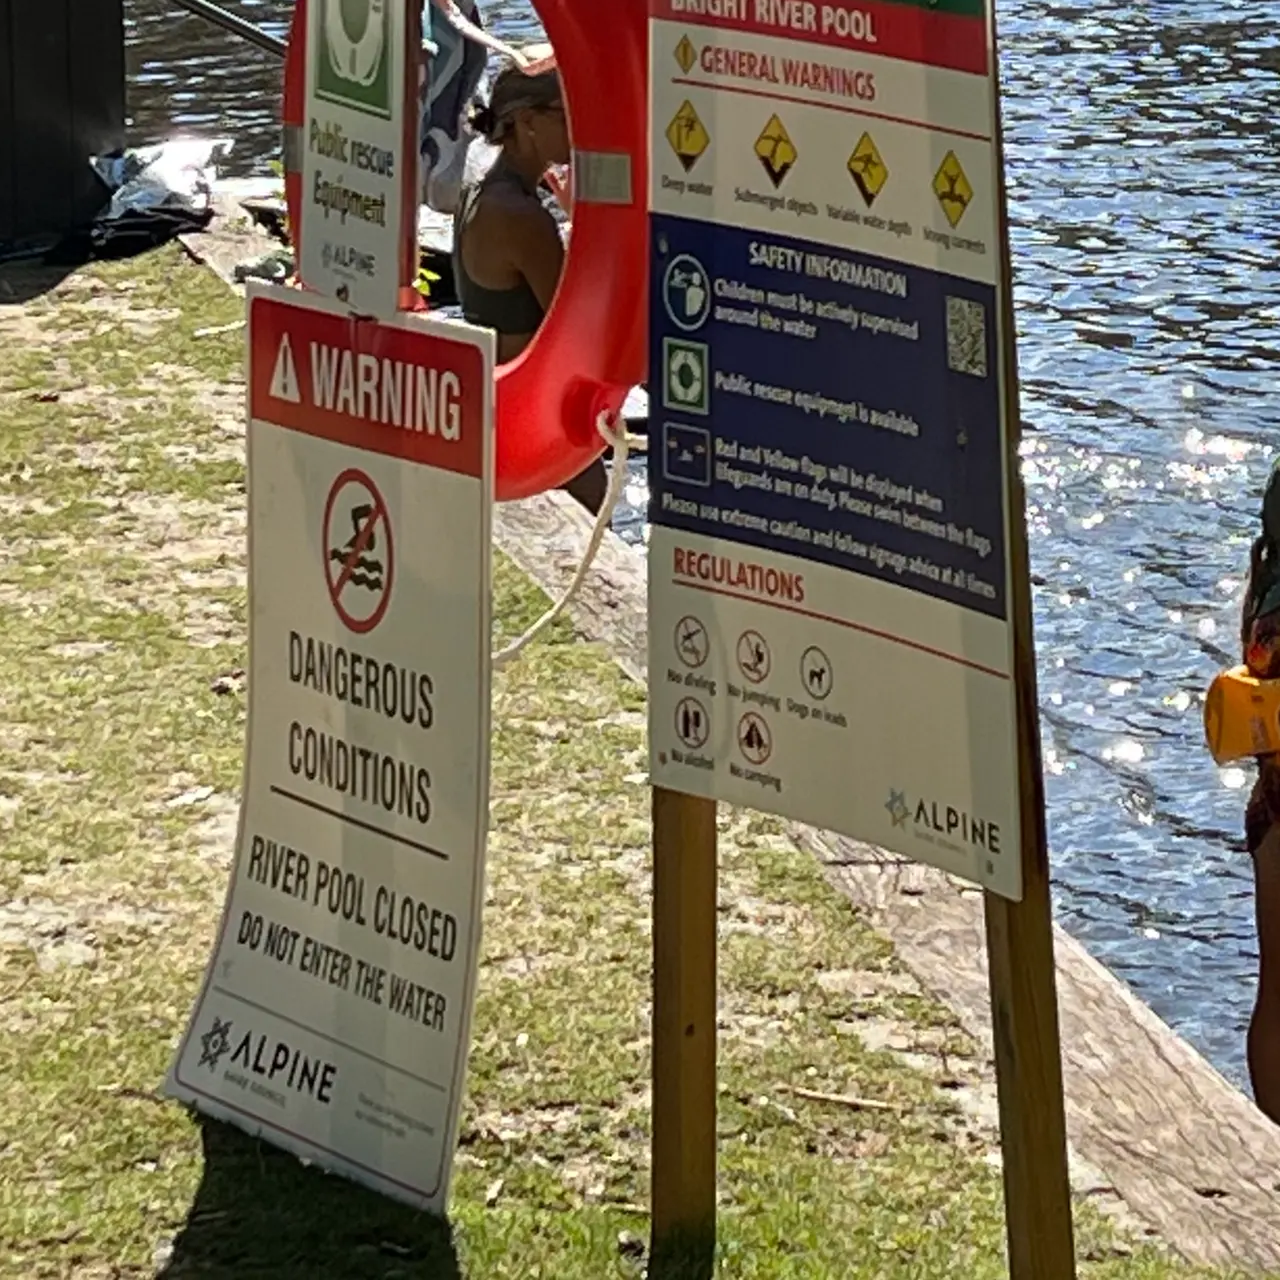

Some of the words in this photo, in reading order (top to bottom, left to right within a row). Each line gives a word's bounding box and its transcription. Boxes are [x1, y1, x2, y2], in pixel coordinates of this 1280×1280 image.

[822, 4, 877, 43] POOL
[700, 45, 779, 84] GENERAL
[782, 58, 876, 101] WARNINGS
[309, 117, 348, 164] Public
[351, 139, 394, 179] rescue
[313, 170, 386, 228] Equipment
[334, 245, 376, 278] ALPINE
[748, 241, 804, 273] SAFETY
[805, 253, 907, 298] INFORMATION
[714, 278, 764, 303] Children
[767, 291, 797, 311] must
[799, 293, 814, 314] be
[816, 301, 859, 330] actively
[861, 311, 918, 340] supervised
[714, 305, 758, 327] around
[759, 310, 781, 332] the
[782, 319, 817, 339] water
[310, 341, 461, 442] WARNING
[715, 370, 752, 396] Public
[753, 382, 793, 405] rescue
[794, 391, 857, 423] equipment
[858, 401, 869, 423] is
[870, 409, 919, 437] available
[715, 437, 738, 459] Red
[739, 445, 761, 464] and
[763, 447, 800, 471] Yellow
[828, 464, 848, 484] will
[850, 468, 864, 489] be
[865, 473, 913, 504] displayed
[914, 489, 943, 513] when
[774, 478, 792, 496] are
[794, 483, 809, 499] on
[838, 491, 872, 517] Please
[873, 504, 901, 524] swim
[902, 508, 946, 538] between
[946, 522, 965, 545] the
[662, 492, 698, 517] Please
[699, 504, 719, 521] use
[721, 509, 769, 533] extreme
[770, 520, 811, 542] caution
[813, 529, 834, 549] and
[834, 530, 868, 558] follow
[869, 543, 907, 575] signage
[908, 556, 940, 581] advice
[941, 566, 953, 585] at
[953, 569, 966, 589] all
[967, 572, 996, 600] times
[673, 547, 805, 603] REGULATIONS
[289, 630, 434, 730] DANGEROUS
[668, 668, 683, 684] No
[684, 672, 717, 697] diving
[726, 682, 742, 698] No
[742, 686, 781, 713] jumping
[786, 697, 810, 719] Dogs
[288, 721, 432, 824] CONDITIONS
[671, 748, 684, 763] No
[730, 762, 744, 778] No
[913, 797, 1001, 855] ALPINE
[247, 834, 310, 901] RIVER
[313, 860, 367, 926] POOL
[373, 884, 457, 962] CLOSED
[237, 910, 264, 951] DO
[263, 921, 300, 966] NOT
[300, 933, 353, 992] ENTER
[352, 960, 387, 1005] THE
[388, 974, 447, 1033] WATER
[231, 1030, 337, 1104] ALPINE
